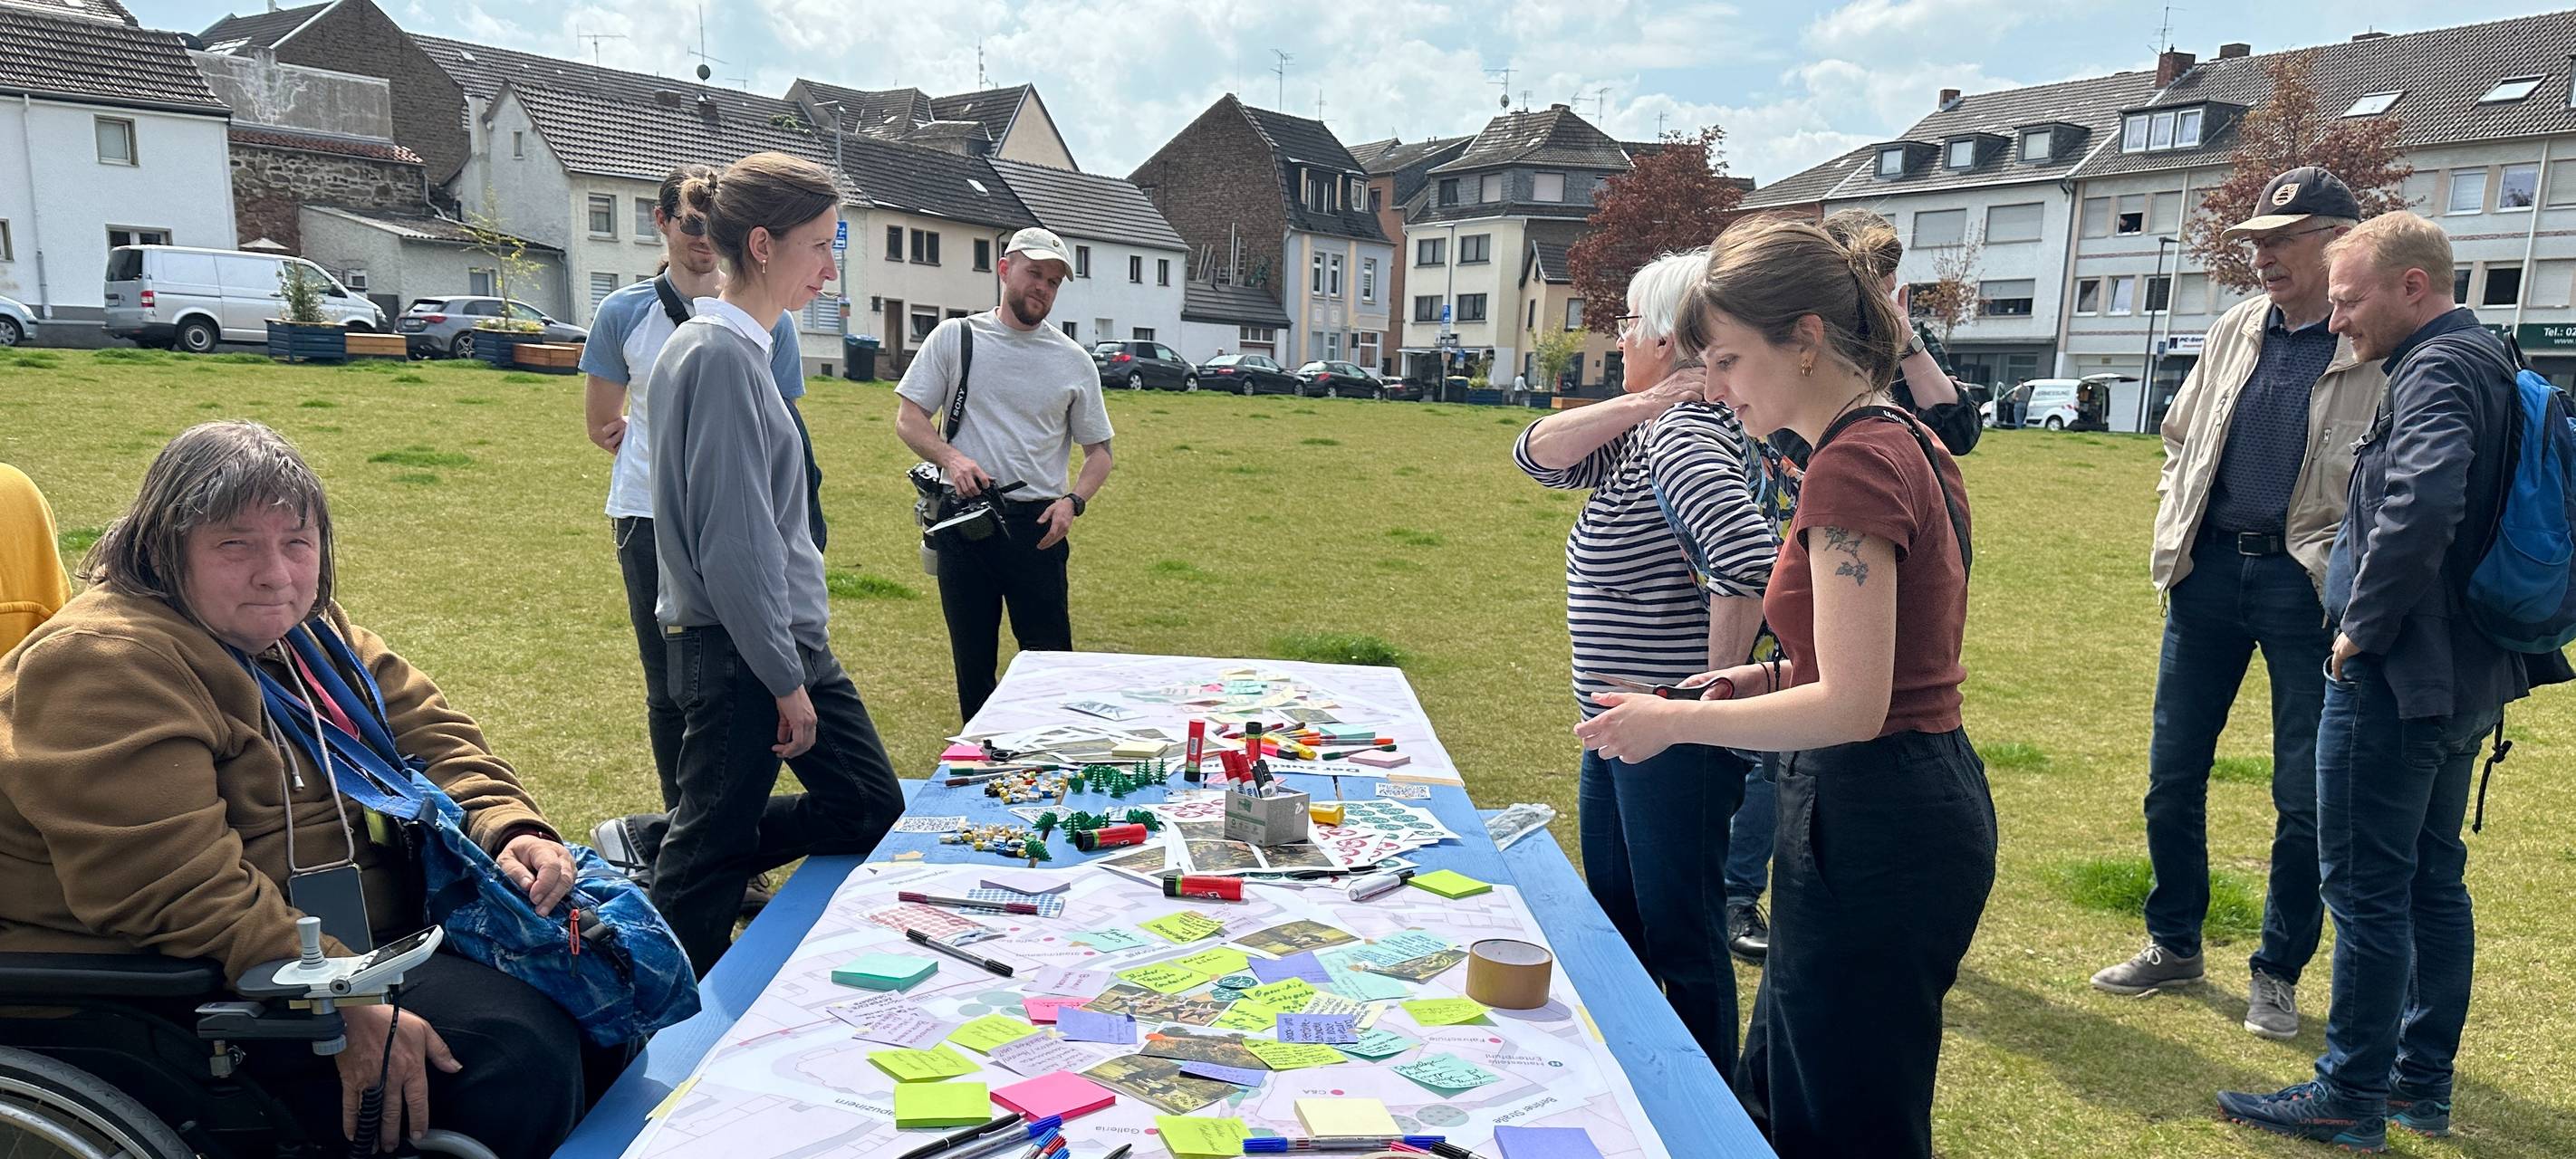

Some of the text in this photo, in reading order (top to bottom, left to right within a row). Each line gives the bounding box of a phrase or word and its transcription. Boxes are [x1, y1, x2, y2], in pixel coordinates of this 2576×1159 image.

[2543, 327, 2563, 337] Tel.:
[953, 388, 965, 417] SONY
[1523, 1097, 1558, 1112] Berliner
[1095, 1125, 1139, 1135] Galleria
